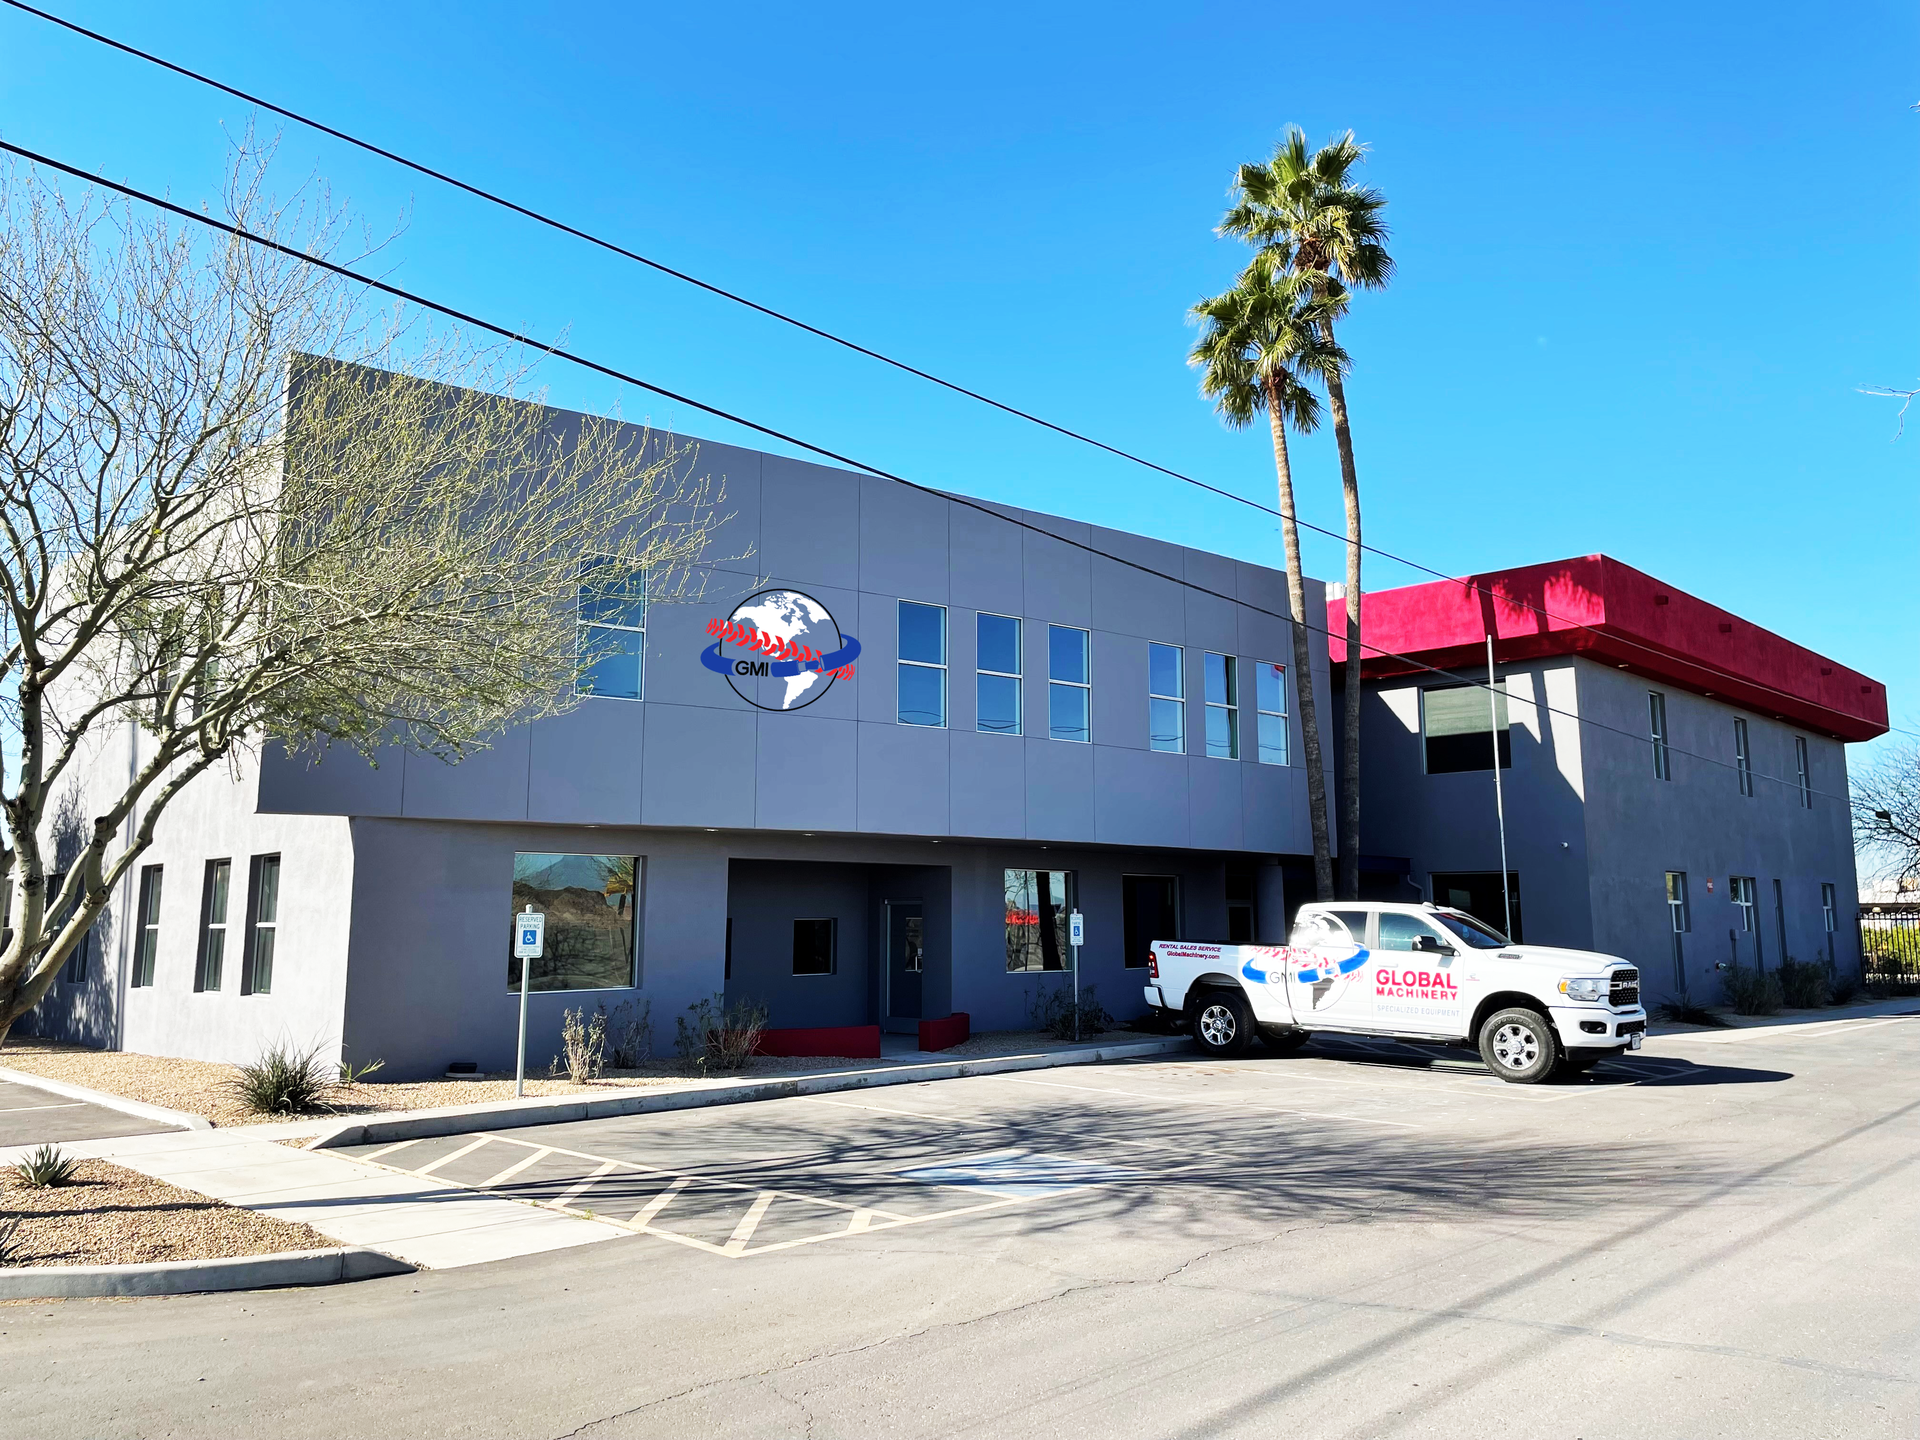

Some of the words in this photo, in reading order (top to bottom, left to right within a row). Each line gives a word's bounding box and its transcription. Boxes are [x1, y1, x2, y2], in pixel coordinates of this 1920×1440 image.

[735, 660, 769, 677] GMI
[1166, 950, 1220, 960] GlobalMachinery.com
[1198, 945, 1222, 953] SERVICE
[1269, 971, 1296, 984] GMI
[1376, 969, 1458, 989] GLOBAL
[1376, 986, 1458, 1001] MACHINERY
[1377, 1004, 1419, 1014] SPECIALIZED
[1421, 1007, 1460, 1017] EQUIPMENT
